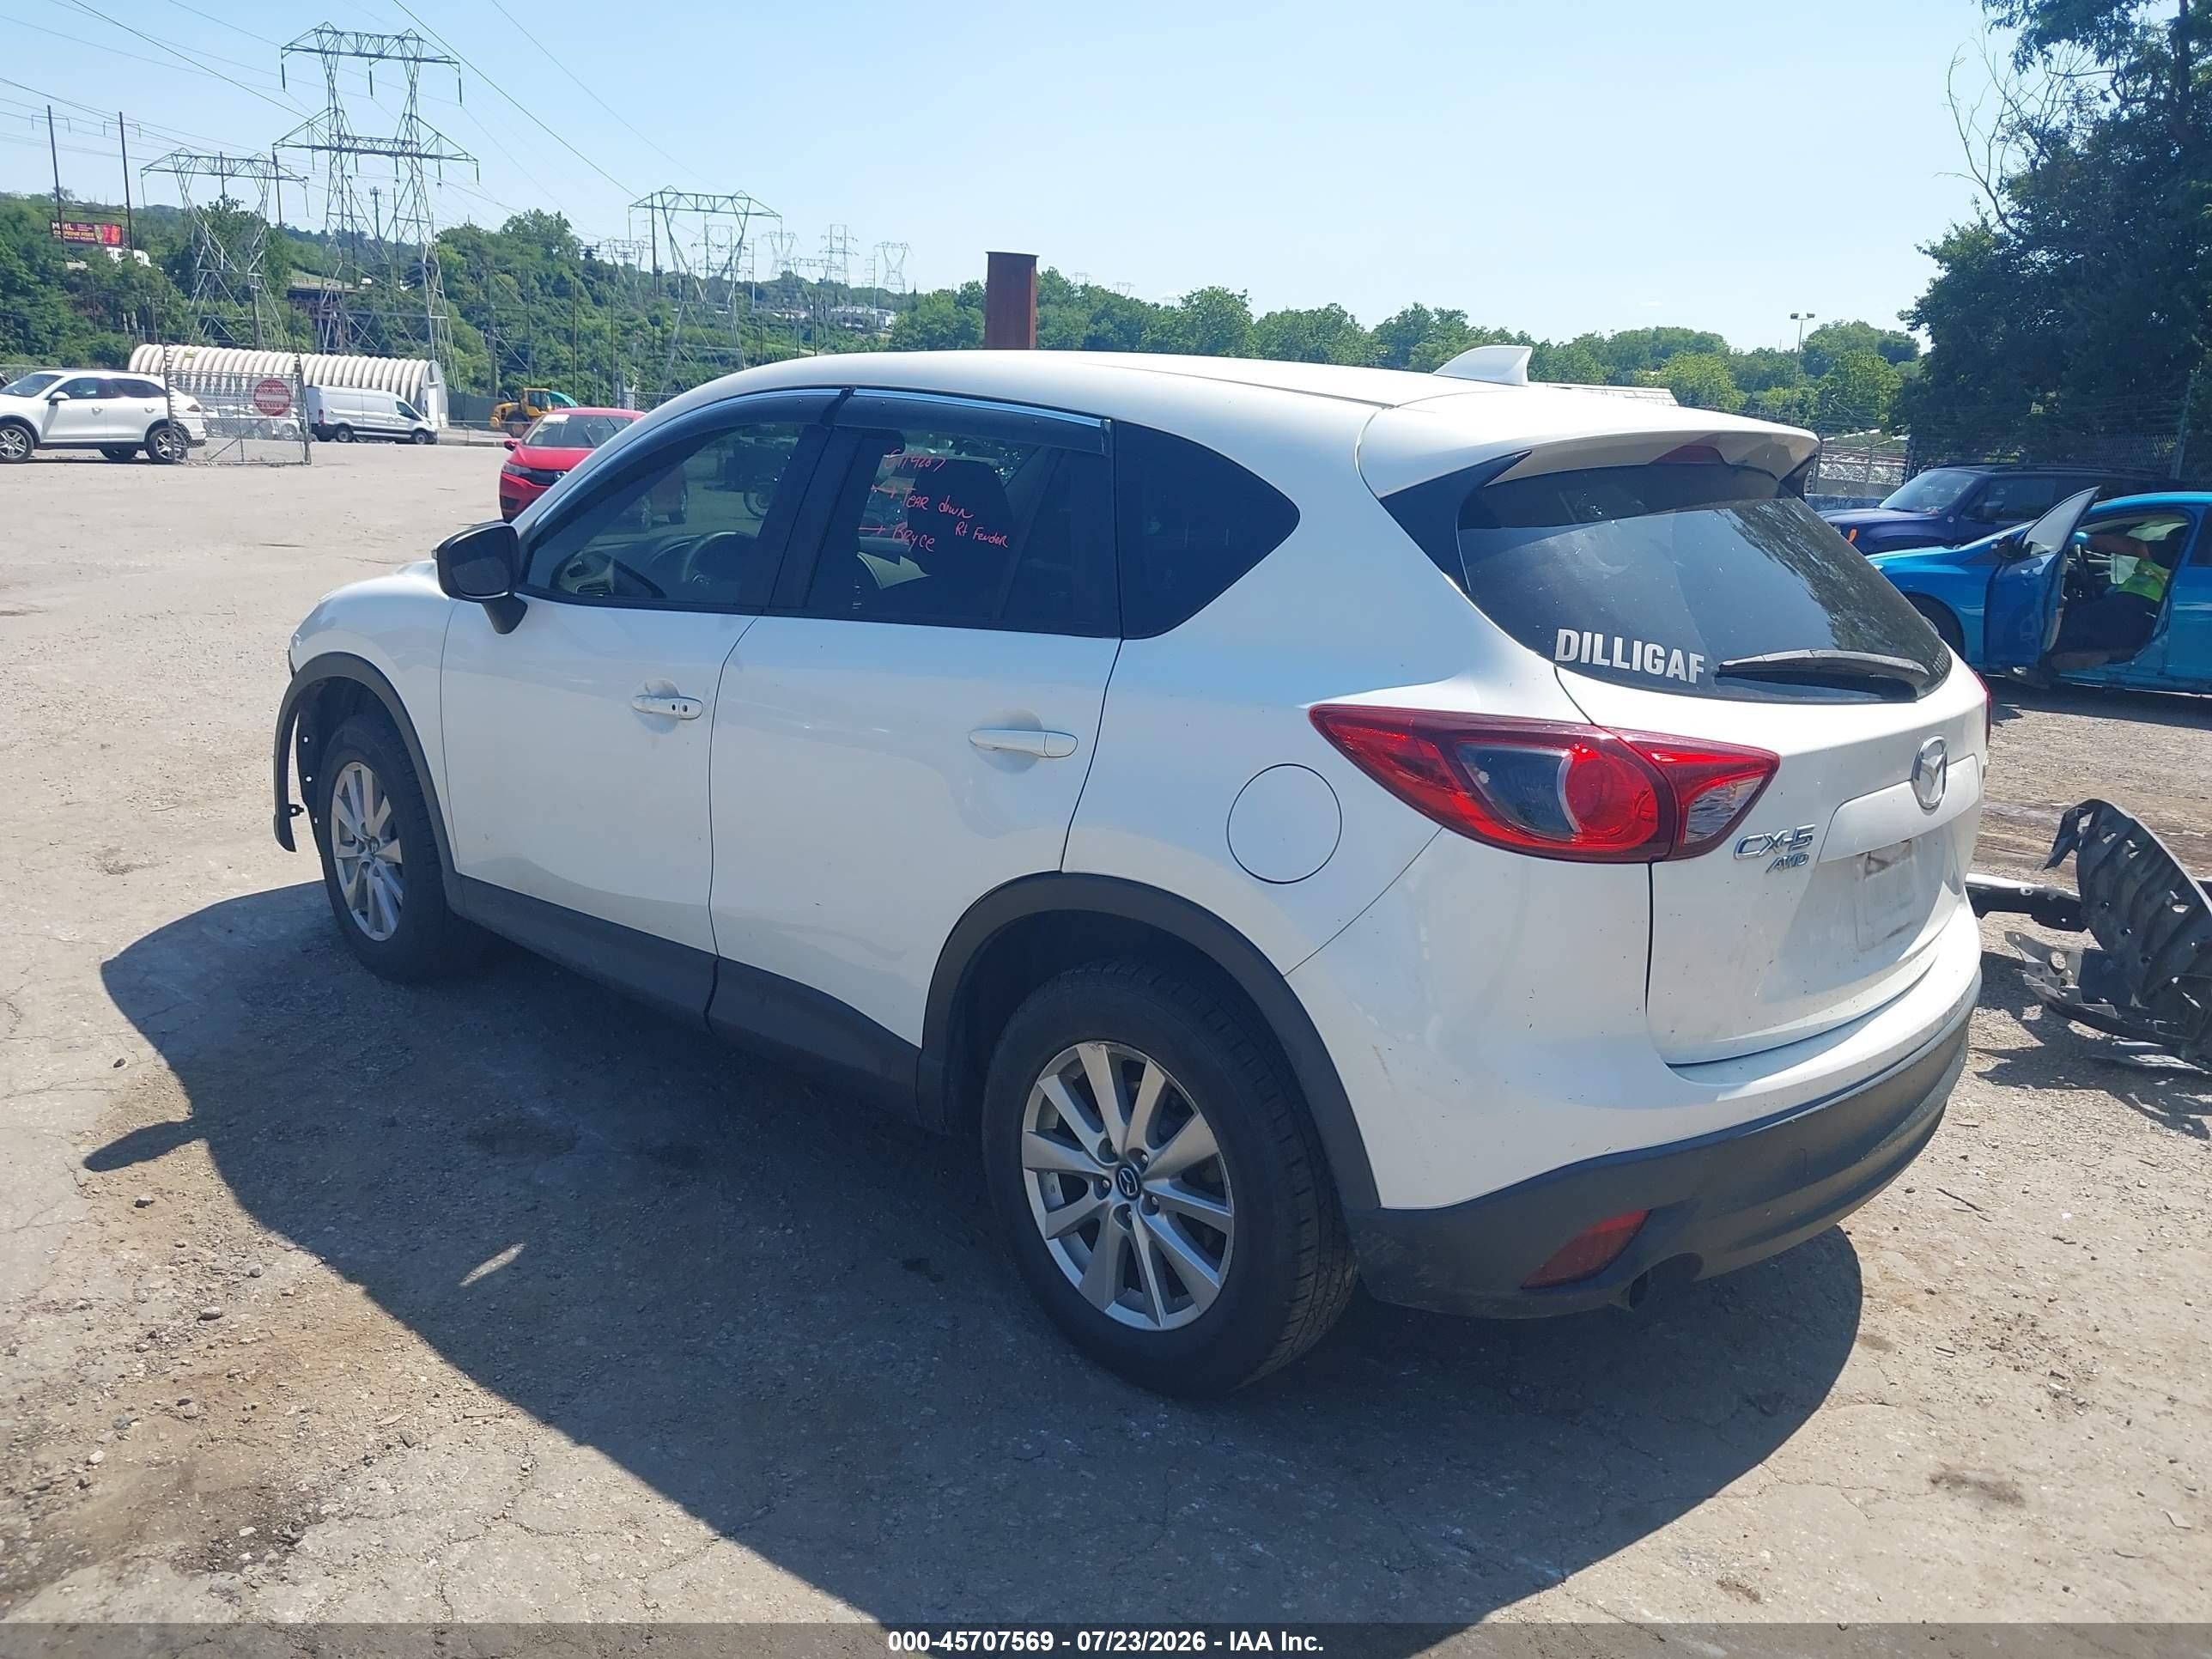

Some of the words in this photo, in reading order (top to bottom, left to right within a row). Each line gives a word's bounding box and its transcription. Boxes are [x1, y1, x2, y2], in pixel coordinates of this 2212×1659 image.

[938, 495, 974, 519] down
[1554, 629, 1705, 684] DILLIGAF
[1734, 823, 1815, 860] CX-5
[1765, 853, 1809, 873] AWD
